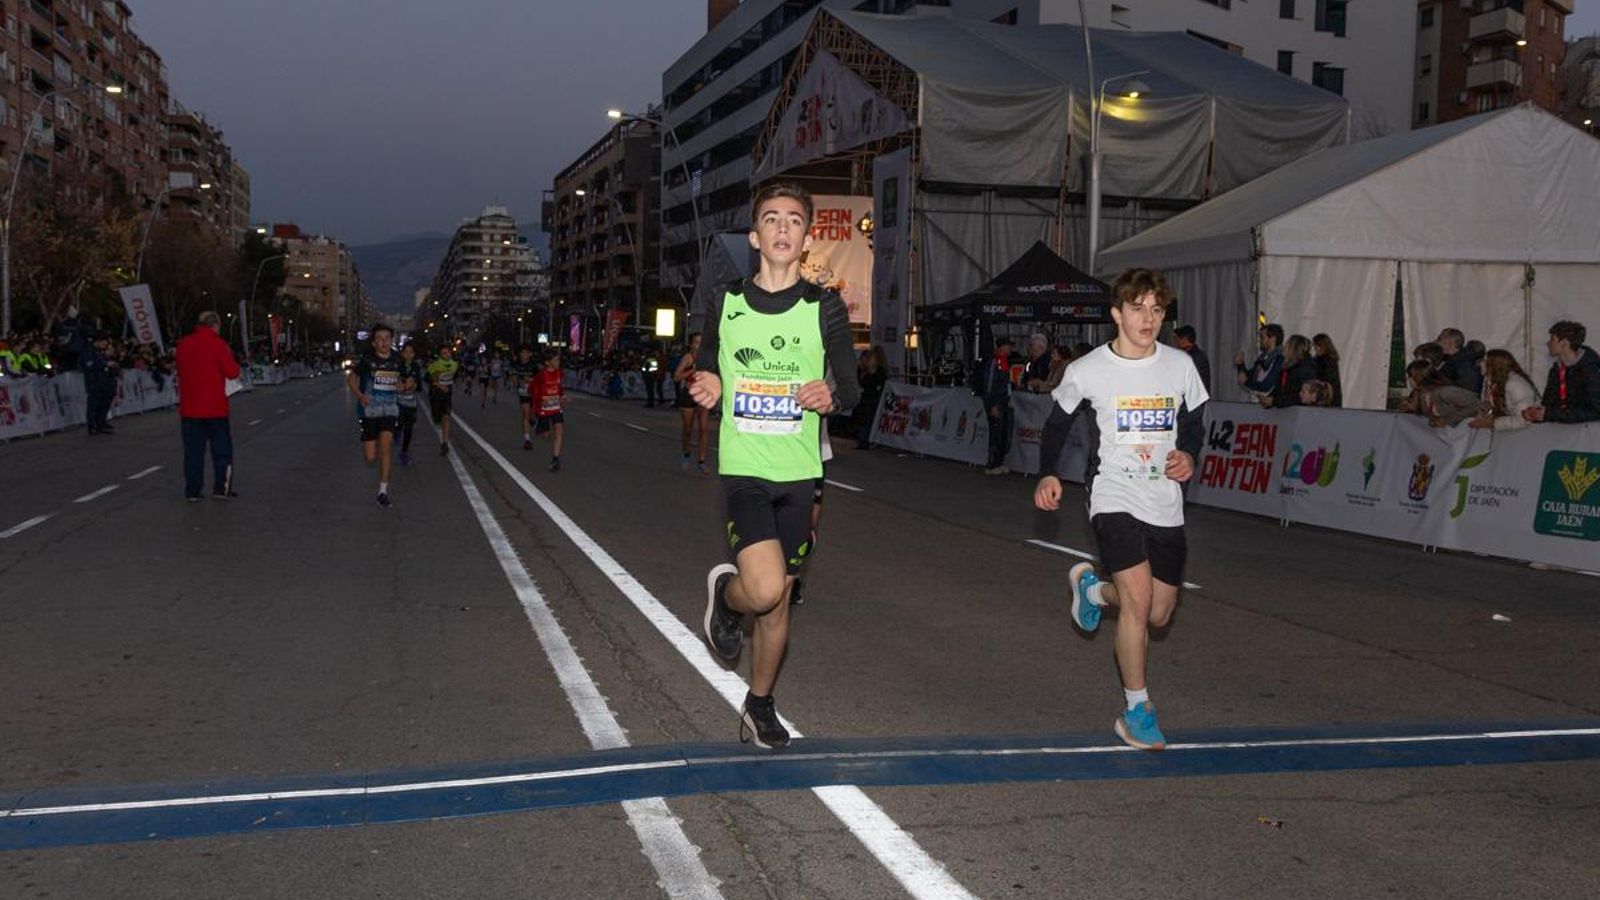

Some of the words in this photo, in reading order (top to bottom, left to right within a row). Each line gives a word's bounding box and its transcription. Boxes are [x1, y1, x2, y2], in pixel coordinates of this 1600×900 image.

[816, 209, 851, 224] SAN
[811, 225, 851, 241] TON
[763, 361, 800, 373] Unicaja
[736, 393, 802, 415] 10340
[1118, 409, 1174, 426] 10551
[1208, 420, 1234, 452] 42
[1232, 423, 1278, 458] SAN
[1468, 495, 1480, 505] DE
[1541, 499, 1566, 513] CAJA
